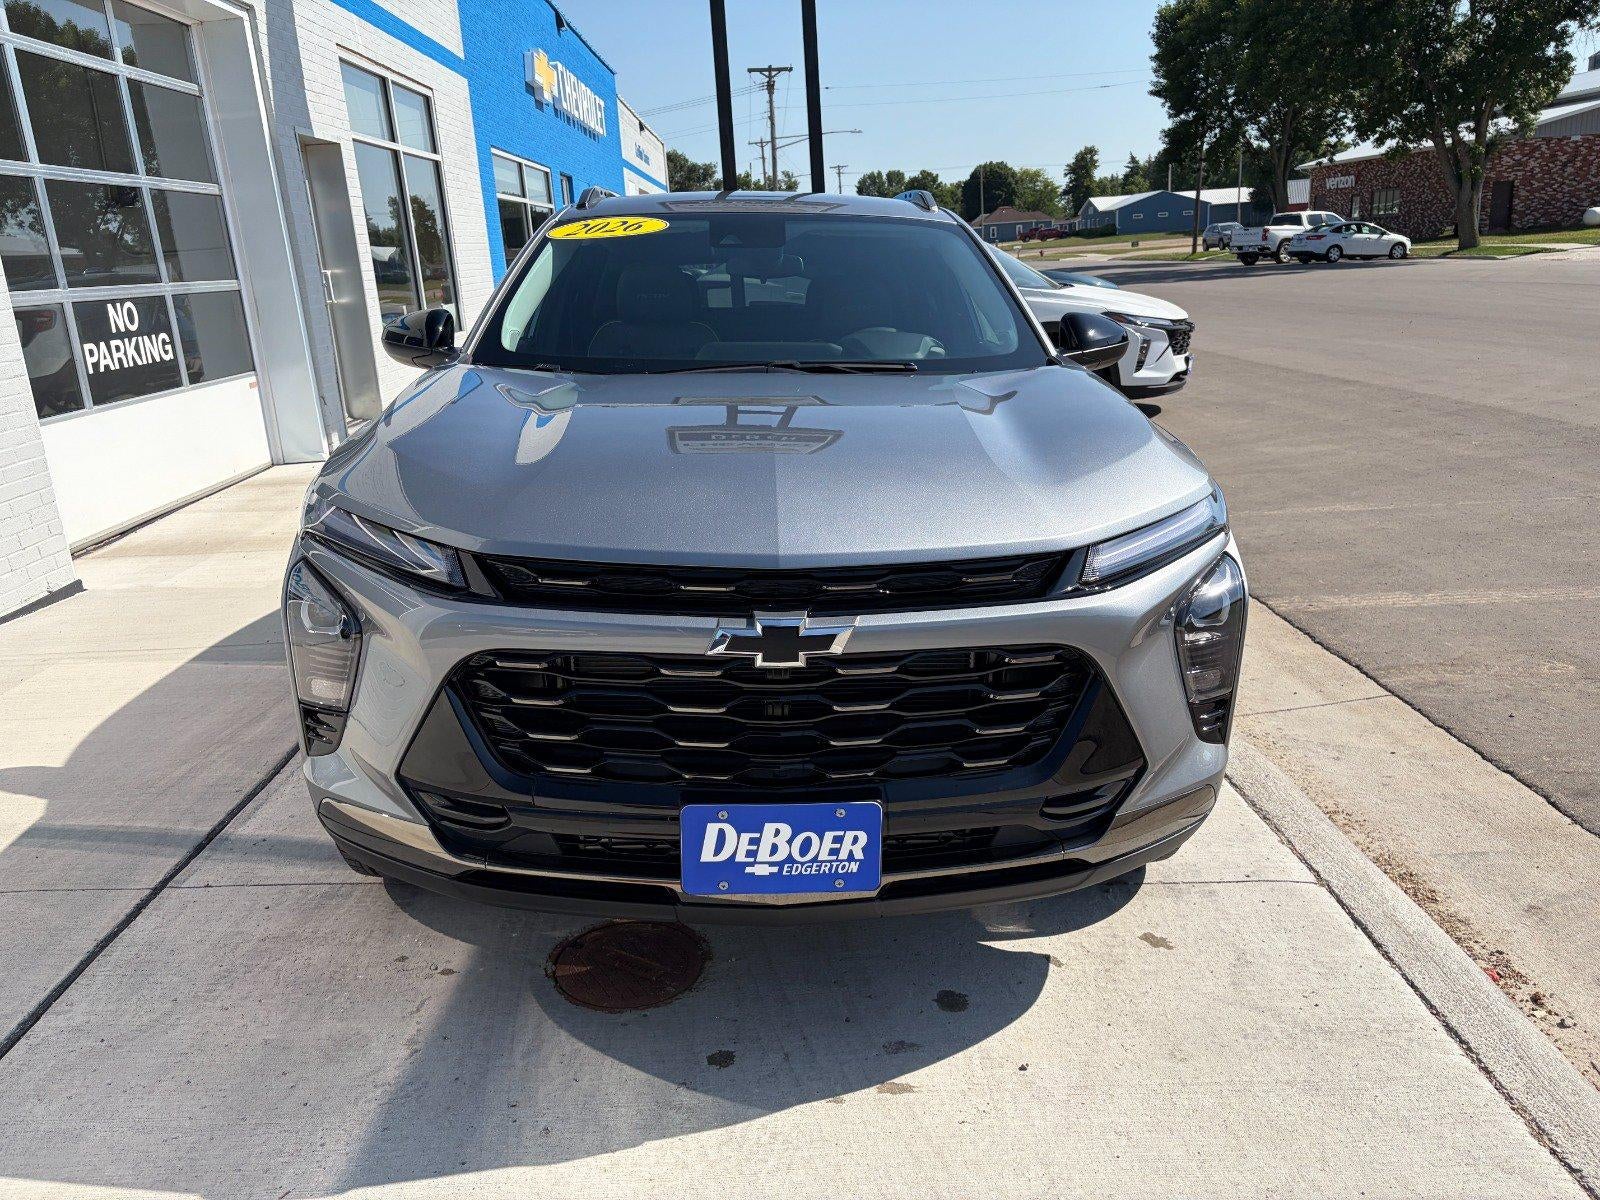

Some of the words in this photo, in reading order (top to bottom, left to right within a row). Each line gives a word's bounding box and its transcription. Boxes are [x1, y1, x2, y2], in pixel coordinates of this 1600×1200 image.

[1325, 173, 1356, 190] verizon
[562, 220, 647, 237] 2026
[106, 301, 139, 334] NO
[83, 332, 174, 375] PARKING
[782, 861, 859, 876] EDGERTON
